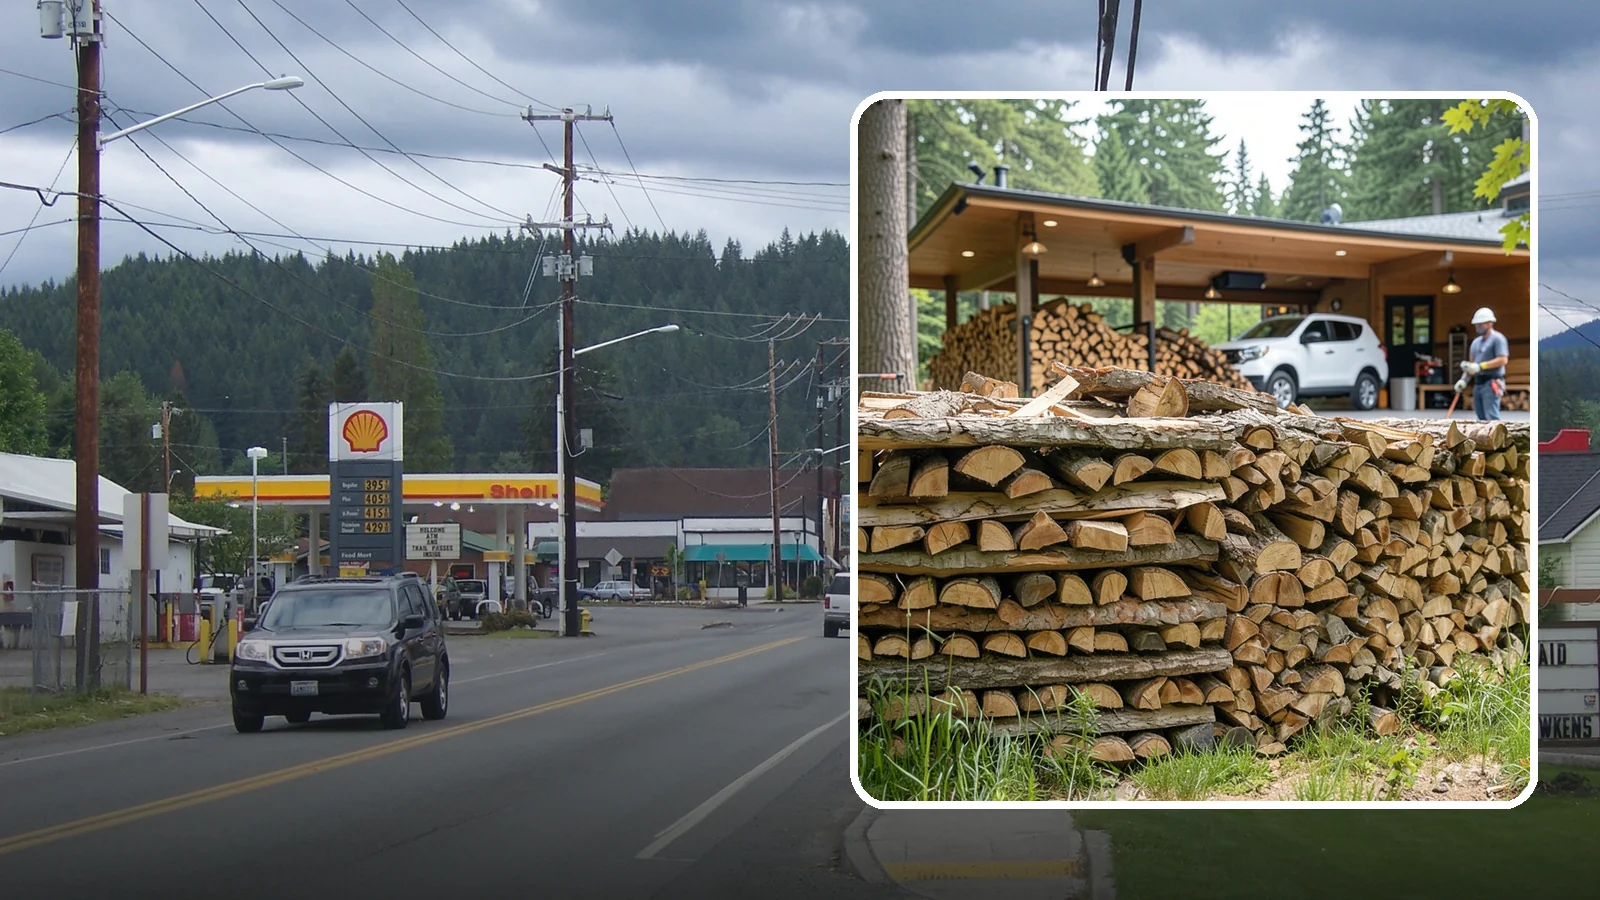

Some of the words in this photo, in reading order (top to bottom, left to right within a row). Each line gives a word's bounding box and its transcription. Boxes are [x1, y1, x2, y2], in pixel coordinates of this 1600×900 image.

[366, 480, 384, 490] 395
[490, 484, 547, 499] Shell
[366, 494, 384, 504] 405
[366, 508, 384, 518] 415
[366, 522, 384, 532] 429
